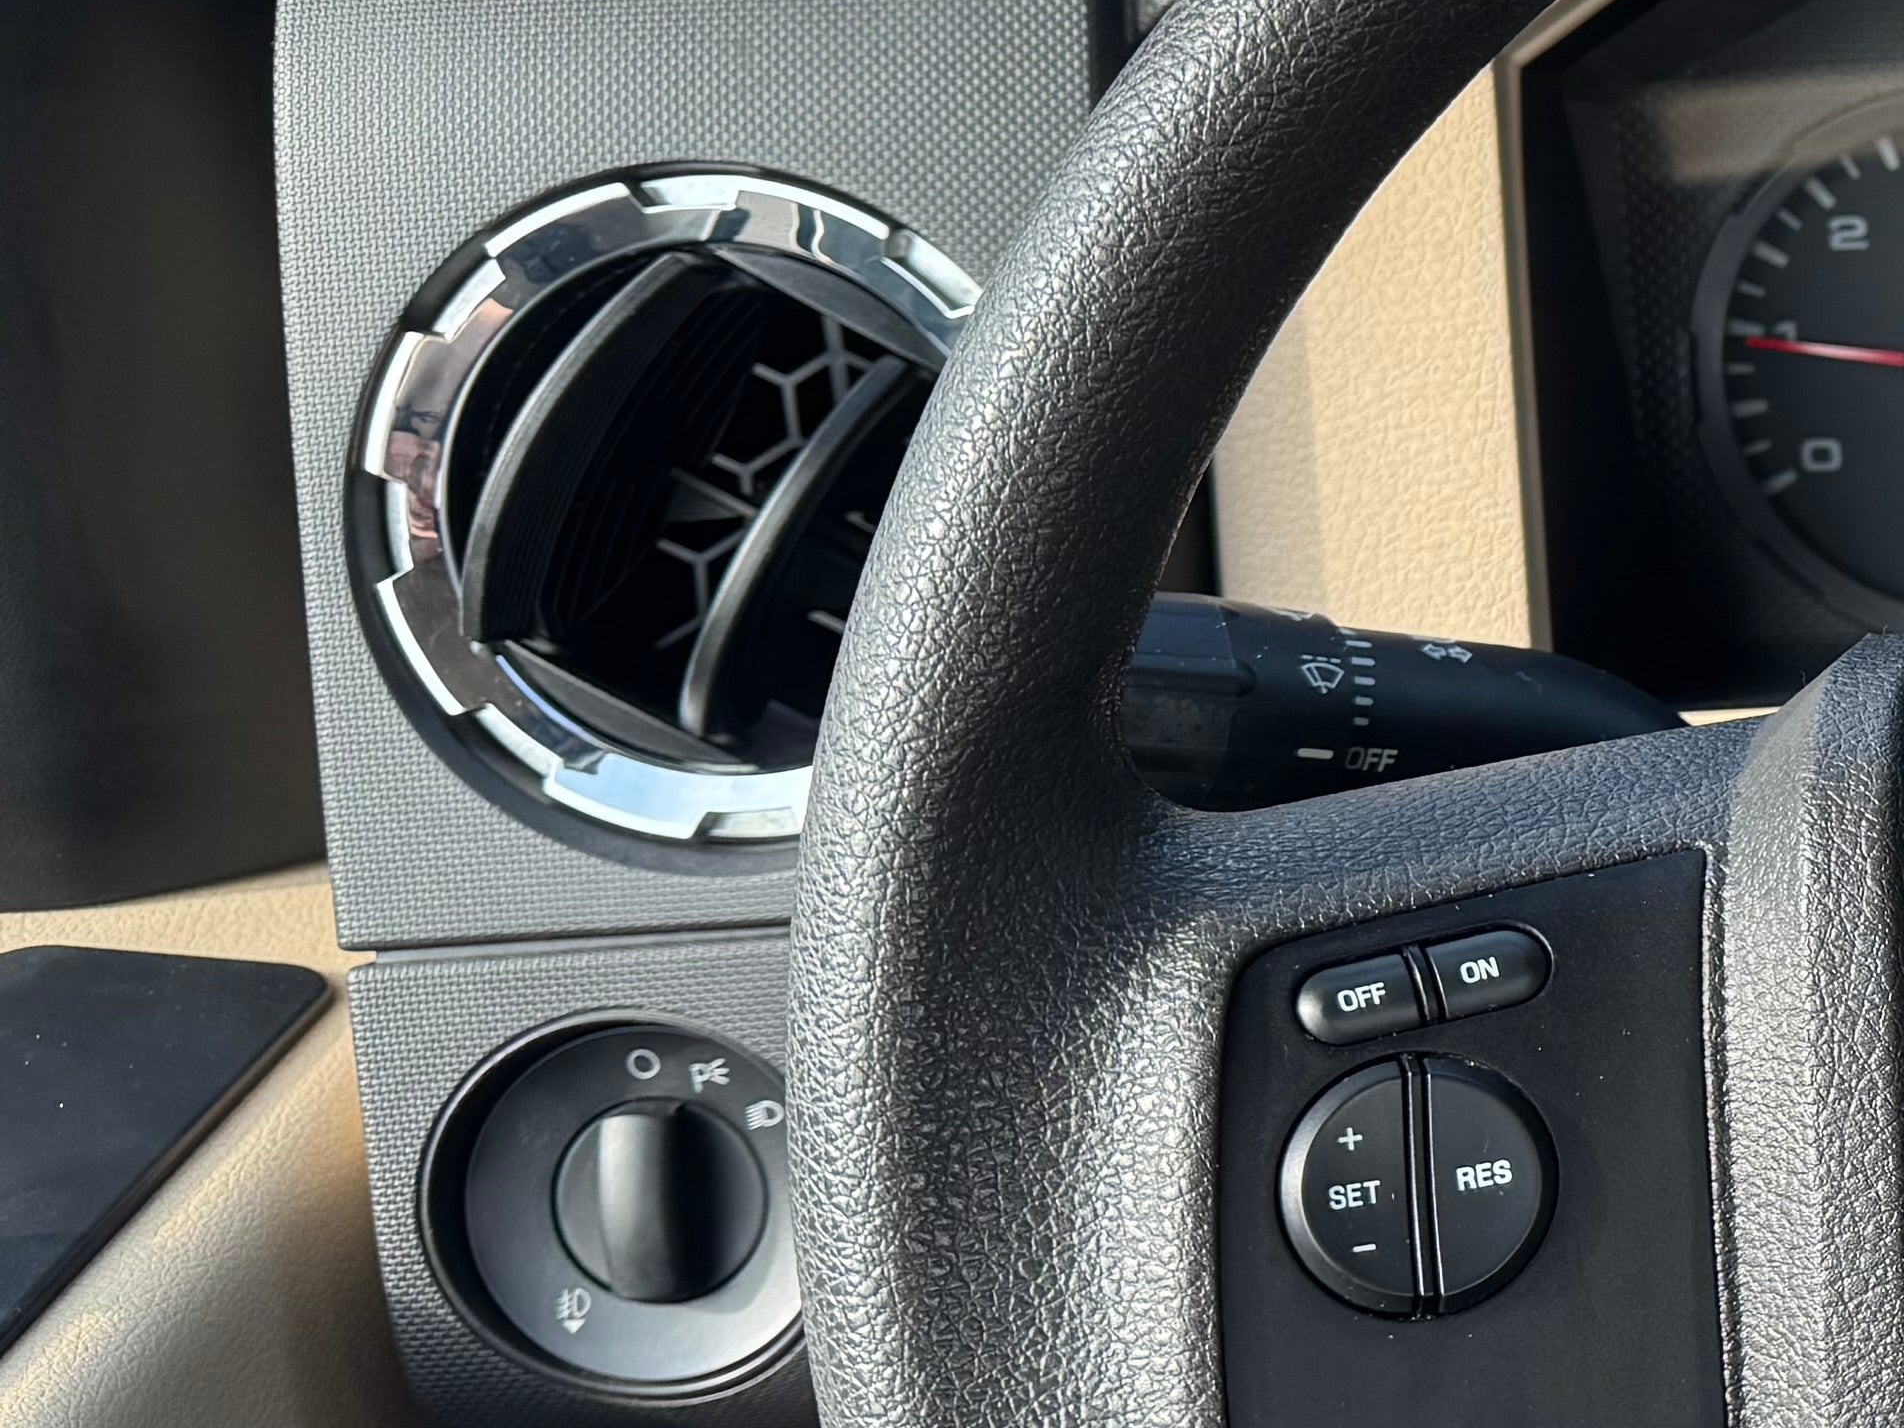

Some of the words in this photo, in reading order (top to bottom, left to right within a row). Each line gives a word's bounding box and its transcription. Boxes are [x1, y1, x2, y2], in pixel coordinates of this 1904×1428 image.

[1828, 216, 1870, 251] 2
[1801, 439, 1843, 472] 0
[1346, 747, 1398, 772] OFF
[1460, 956, 1500, 985] ON
[1337, 982, 1386, 1012] OFF
[1456, 1159, 1513, 1191] RES
[1329, 1180, 1380, 1210] SET
